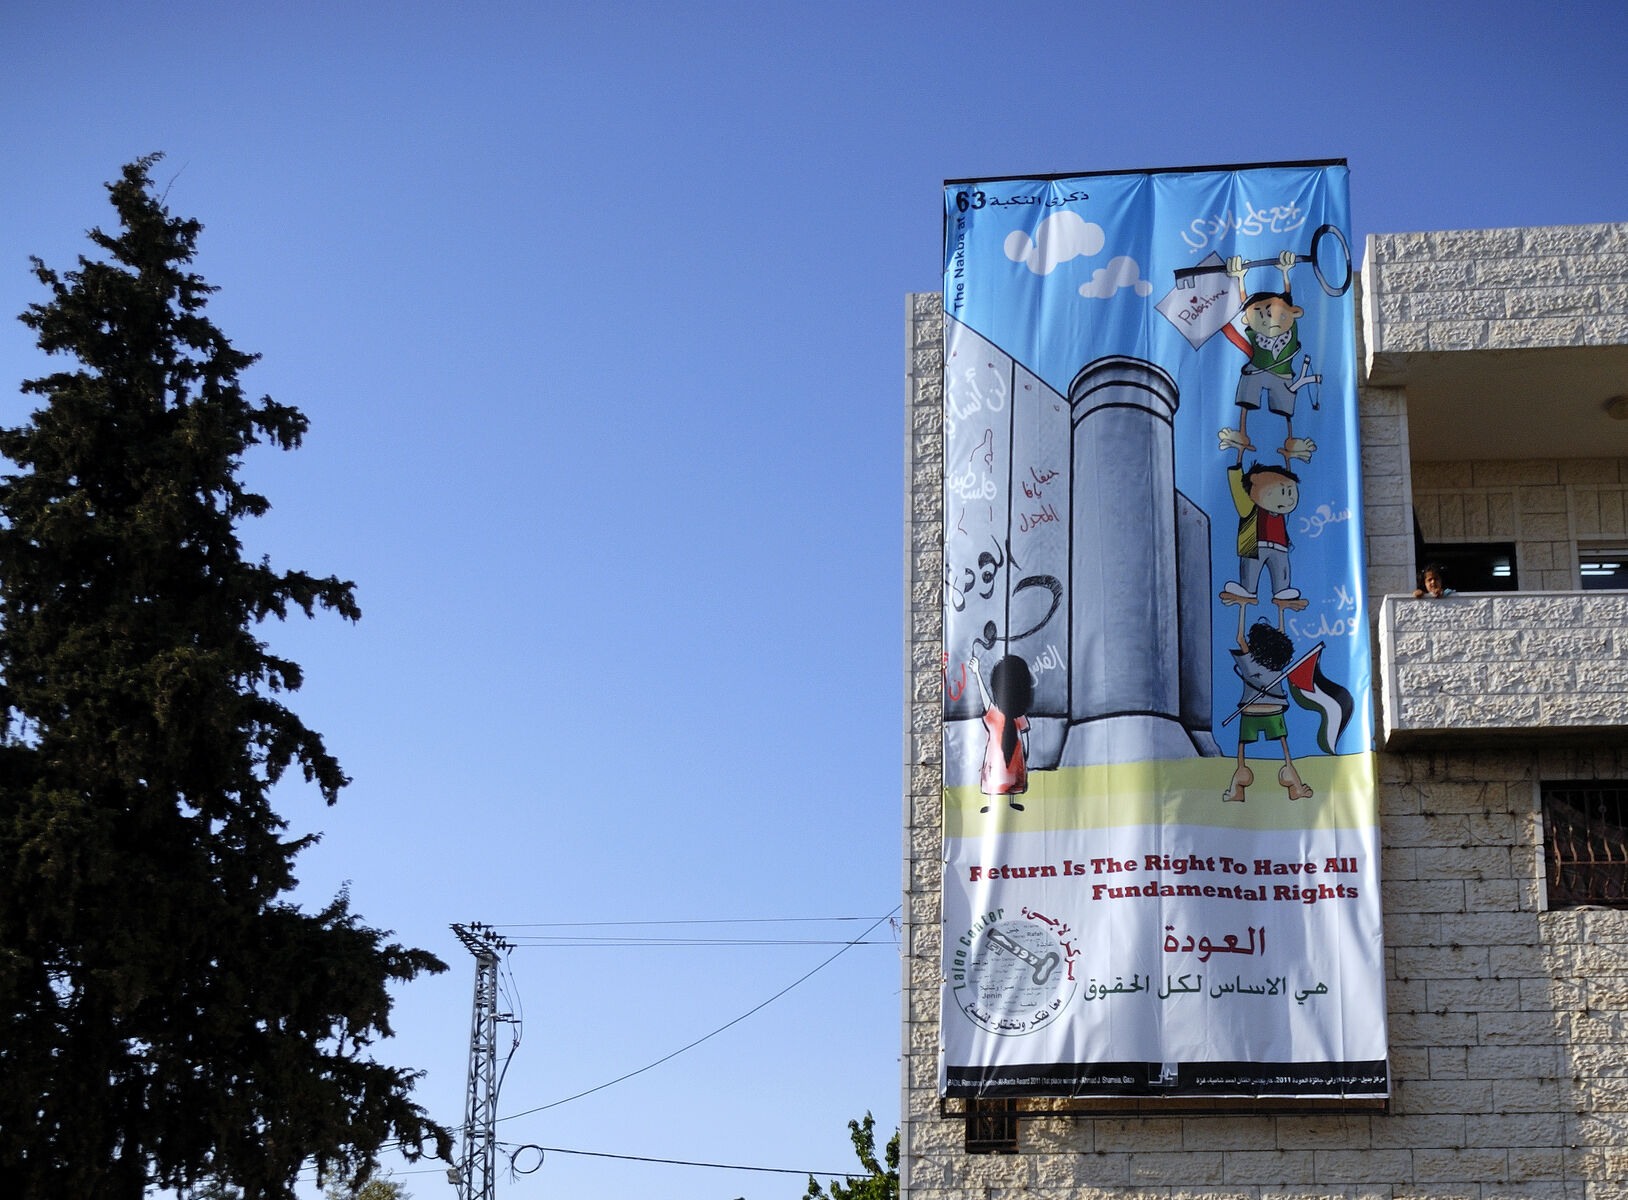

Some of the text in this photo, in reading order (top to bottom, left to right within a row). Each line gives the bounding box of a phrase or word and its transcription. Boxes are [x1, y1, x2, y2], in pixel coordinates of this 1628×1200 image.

[956, 191, 1089, 213] ذكرى النكبة 63
[954, 216, 966, 312] The Nakba at
[1178, 289, 1229, 326] Palestine
[1030, 466, 1060, 486] حيفا
[1020, 503, 1060, 532] المجدل
[1299, 500, 1353, 538] سنعود
[970, 854, 1358, 882] Return Is The Right To Have All
[1092, 881, 1359, 904] Fundamental Rights
[959, 907, 1005, 947] Center
[1163, 925, 1265, 962] العودة
[952, 949, 967, 991] Lajee
[1060, 937, 1082, 981] مركز
[1084, 974, 1149, 1000] الحقوق
[1158, 974, 1202, 999] لكل
[1209, 975, 1286, 999] الاساس
[1295, 982, 1328, 1005] هي
